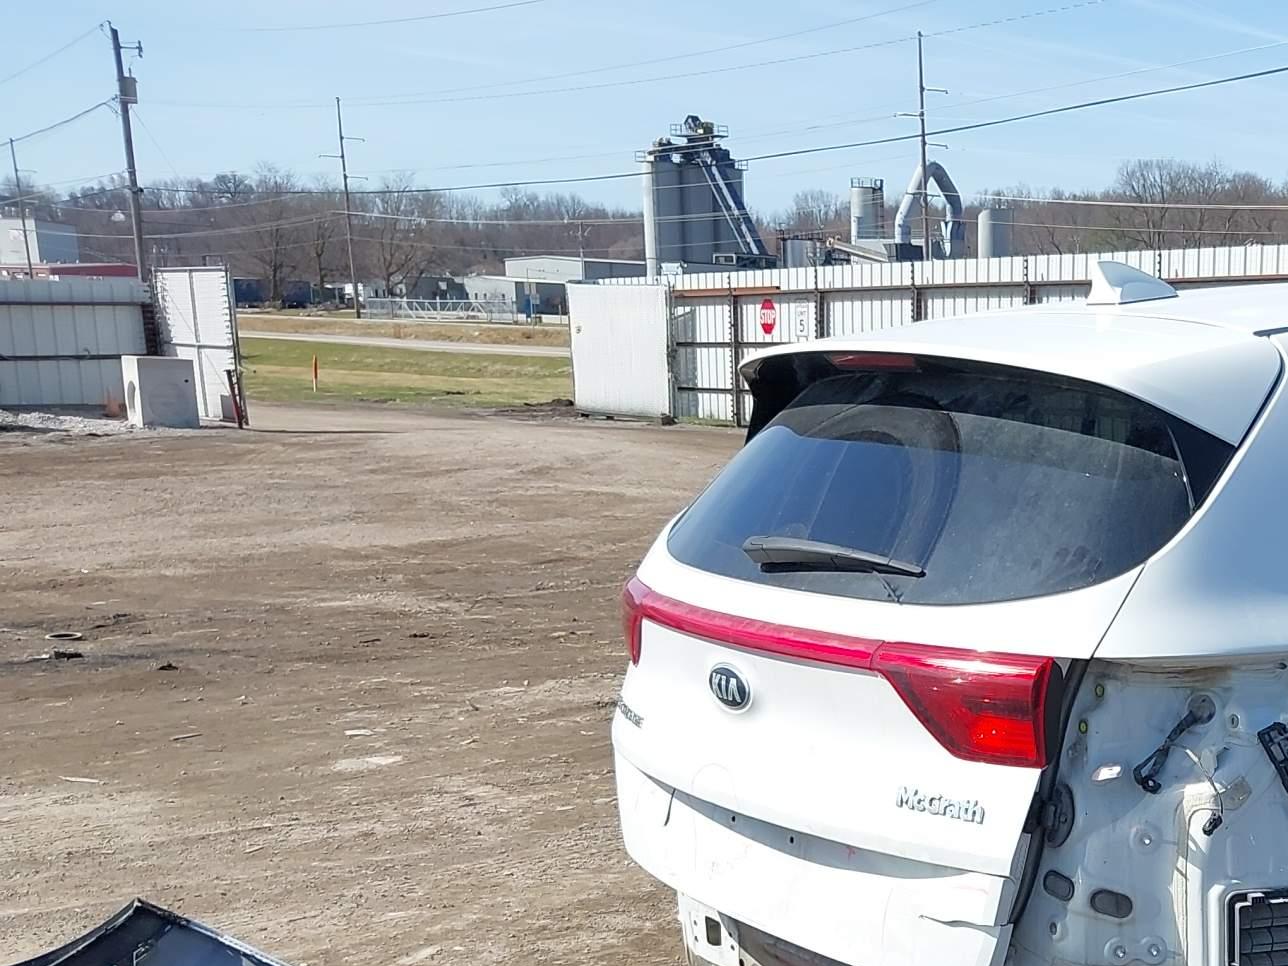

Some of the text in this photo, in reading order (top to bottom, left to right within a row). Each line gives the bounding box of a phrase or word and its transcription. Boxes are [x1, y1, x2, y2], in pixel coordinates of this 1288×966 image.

[760, 309, 776, 325] STOP
[799, 319, 805, 333] 5
[711, 671, 742, 703] KIA
[895, 785, 986, 825] McGrath
